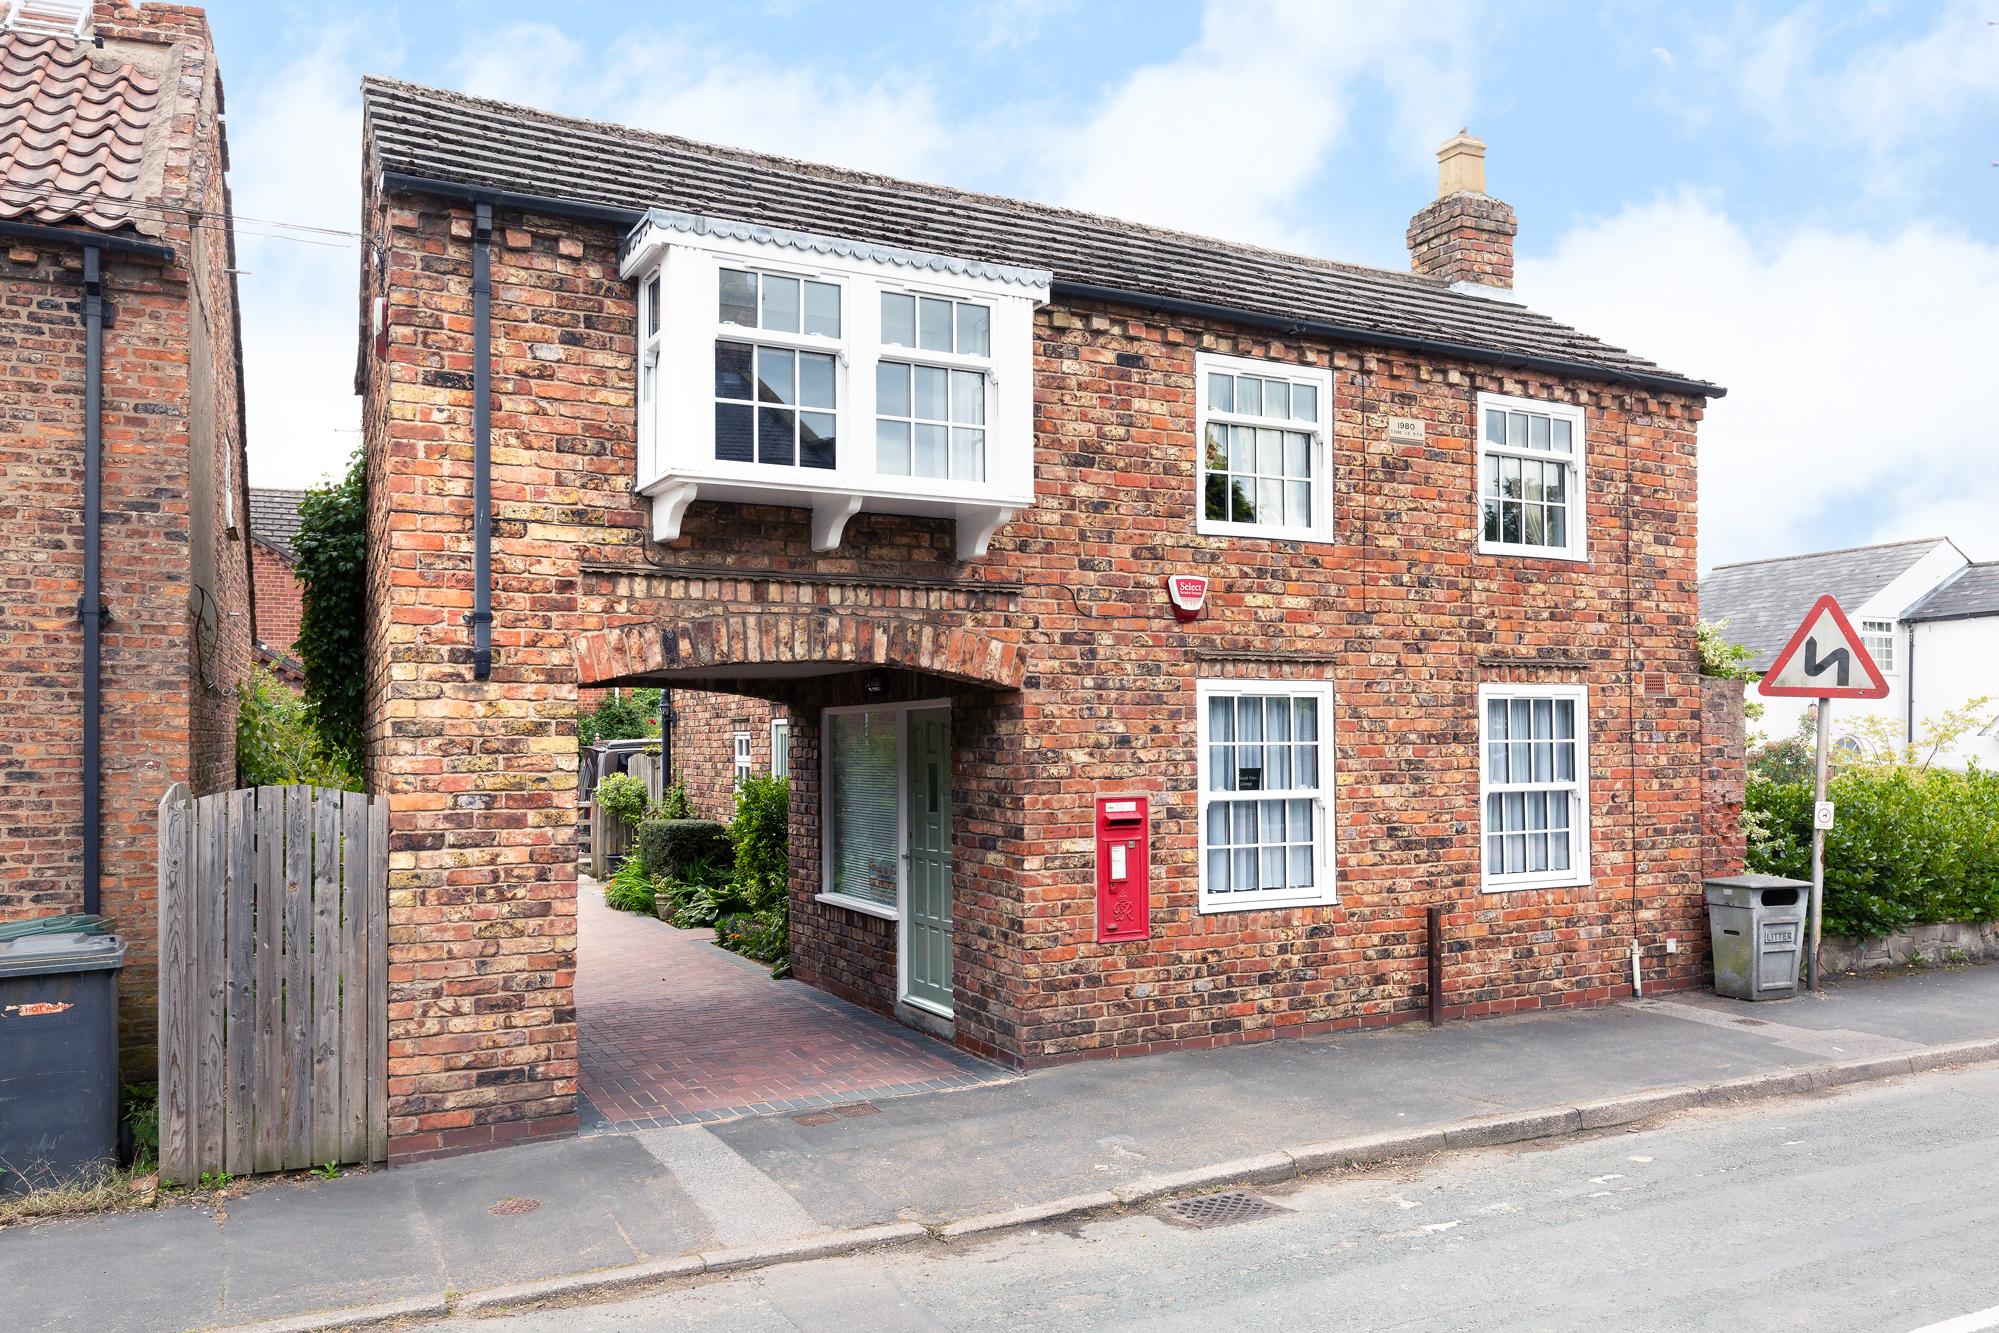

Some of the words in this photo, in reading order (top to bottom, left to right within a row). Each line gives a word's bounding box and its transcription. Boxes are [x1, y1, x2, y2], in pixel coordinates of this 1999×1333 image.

[1397, 422, 1416, 431] 1980
[1179, 581, 1202, 591] Select
[1766, 931, 1792, 942] LITTER
[25, 1005, 43, 1013] HOT
